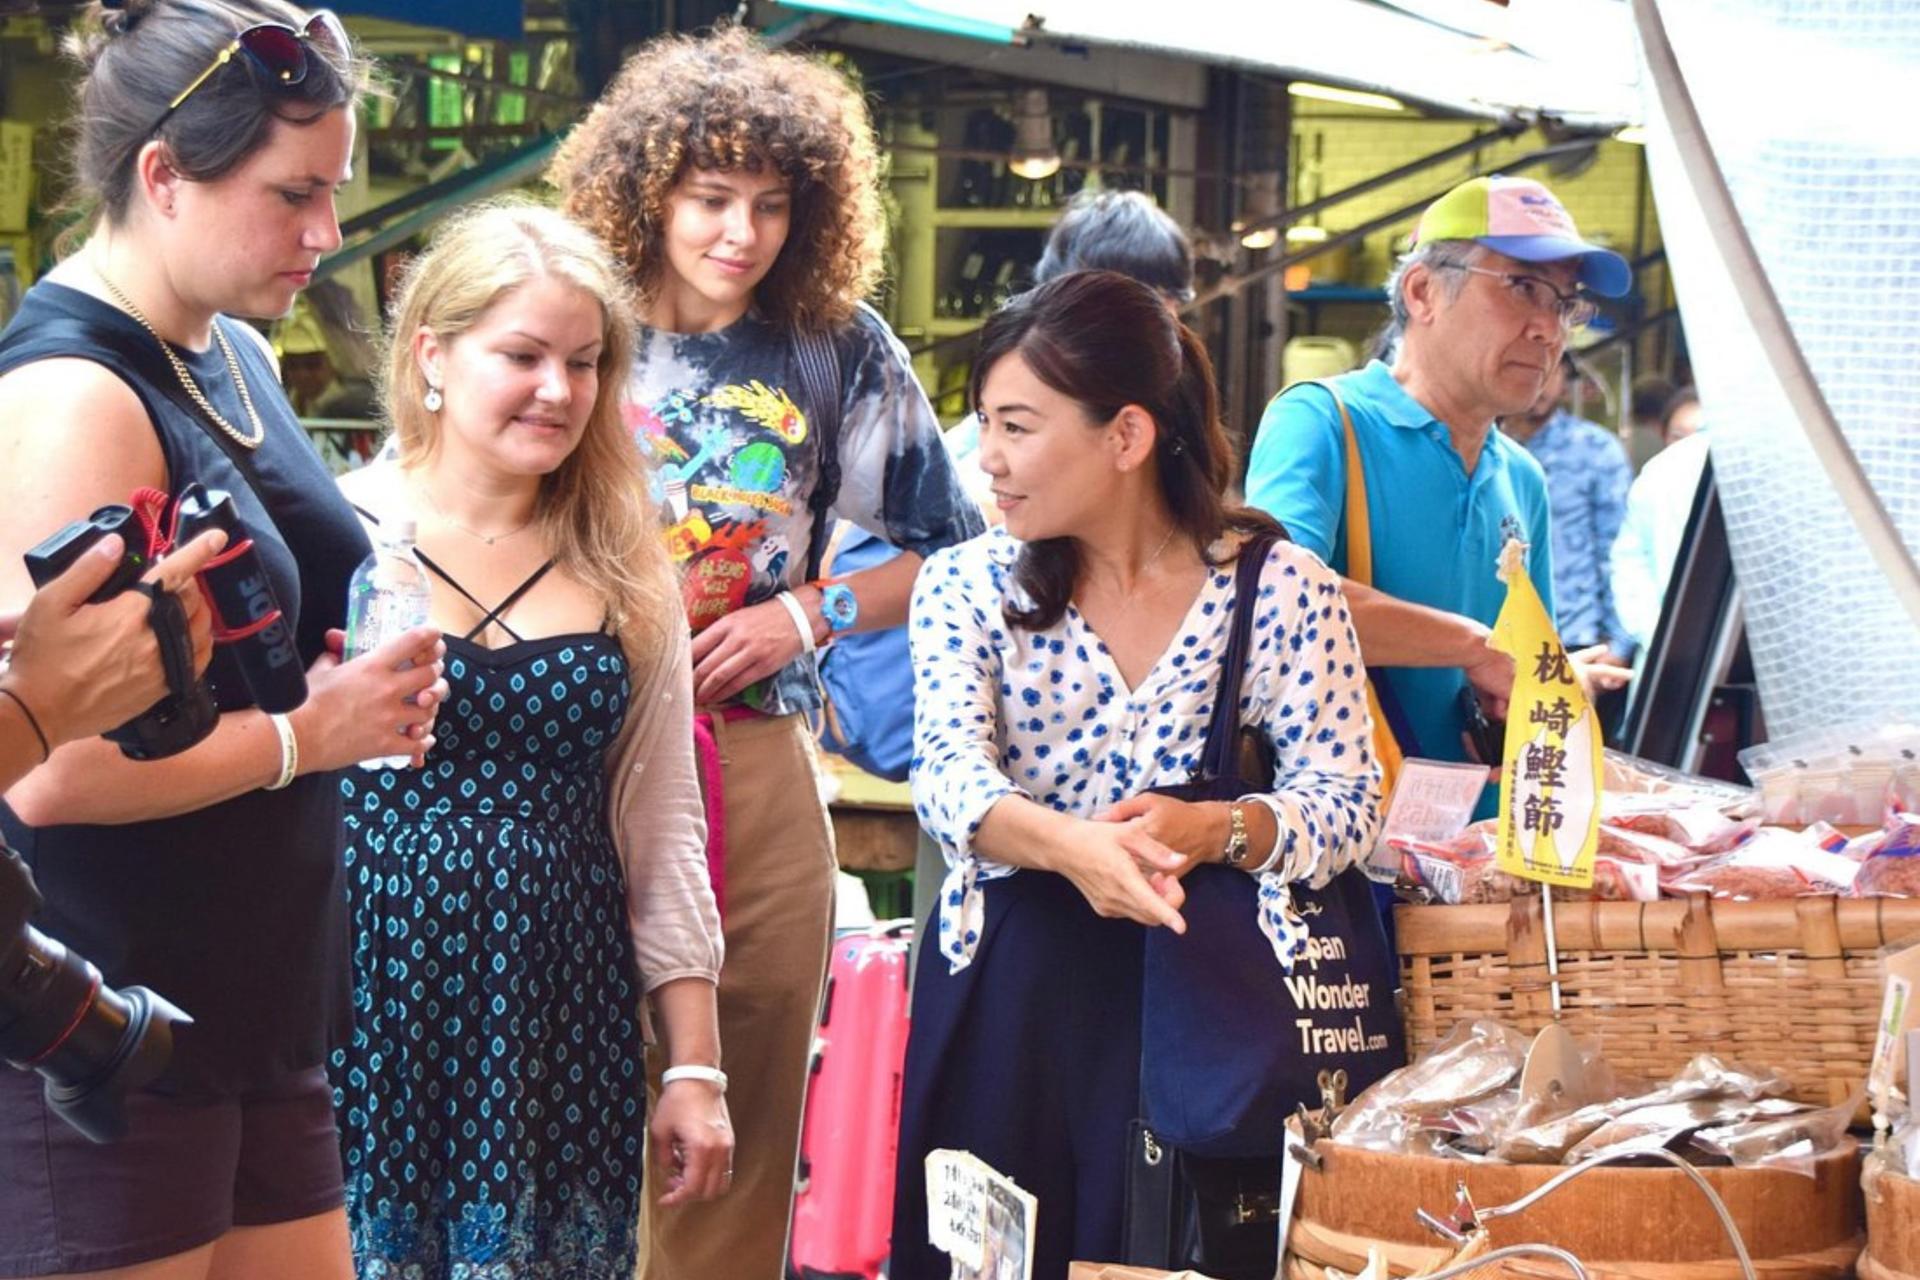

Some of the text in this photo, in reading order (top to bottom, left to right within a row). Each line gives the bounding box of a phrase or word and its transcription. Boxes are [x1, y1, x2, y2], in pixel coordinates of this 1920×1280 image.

[1524, 641, 1575, 837] 枕崎鰹節
[1294, 935, 1347, 971] pan
[1282, 973, 1370, 1010] Wonder
